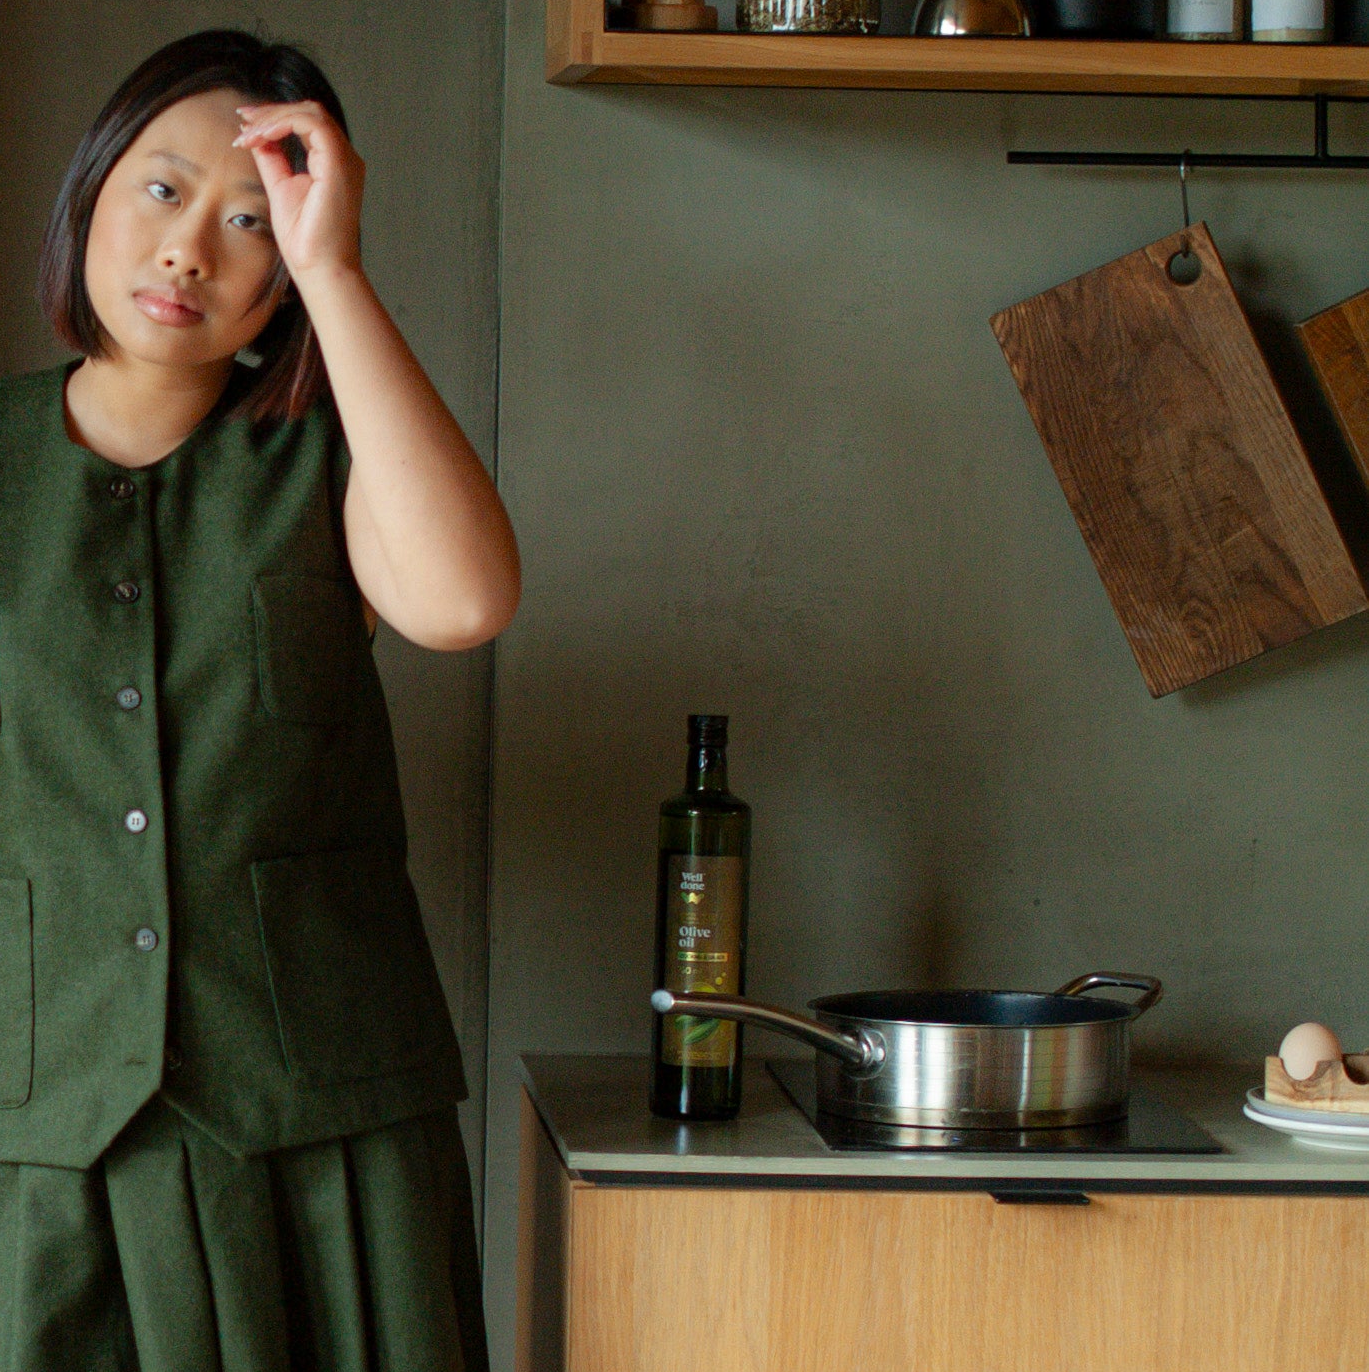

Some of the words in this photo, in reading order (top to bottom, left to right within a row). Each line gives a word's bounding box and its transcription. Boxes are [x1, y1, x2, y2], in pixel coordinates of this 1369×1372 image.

[681, 871, 704, 882] Well
[680, 881, 705, 891] done
[679, 925, 711, 938] Olive
[678, 936, 695, 949] oil
